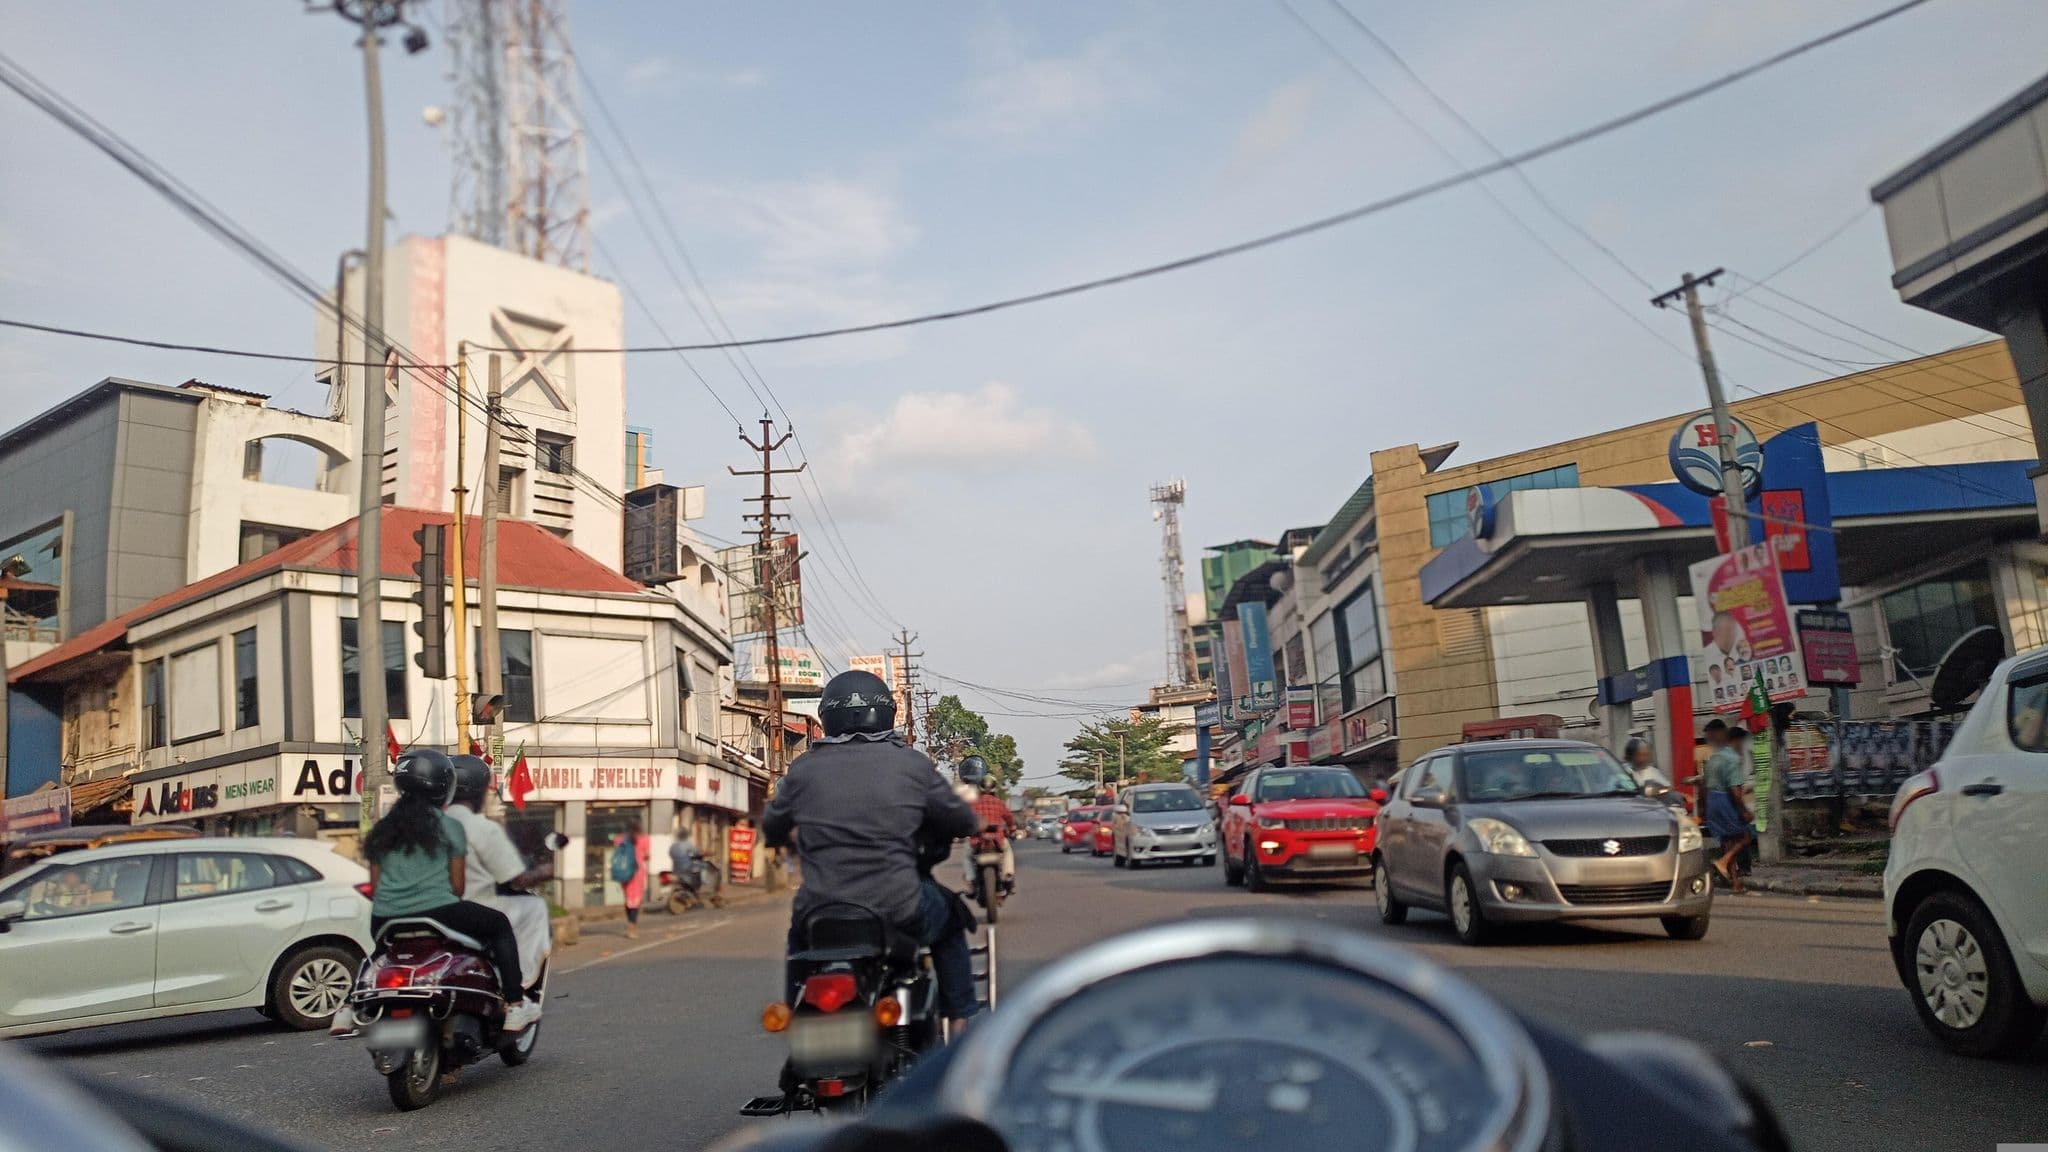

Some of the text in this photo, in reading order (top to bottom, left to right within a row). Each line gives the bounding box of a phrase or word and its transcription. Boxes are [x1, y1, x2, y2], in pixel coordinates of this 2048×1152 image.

[589, 767, 663, 789] JEWELLERY
[158, 778, 275, 816] Adams MENS WEAR
